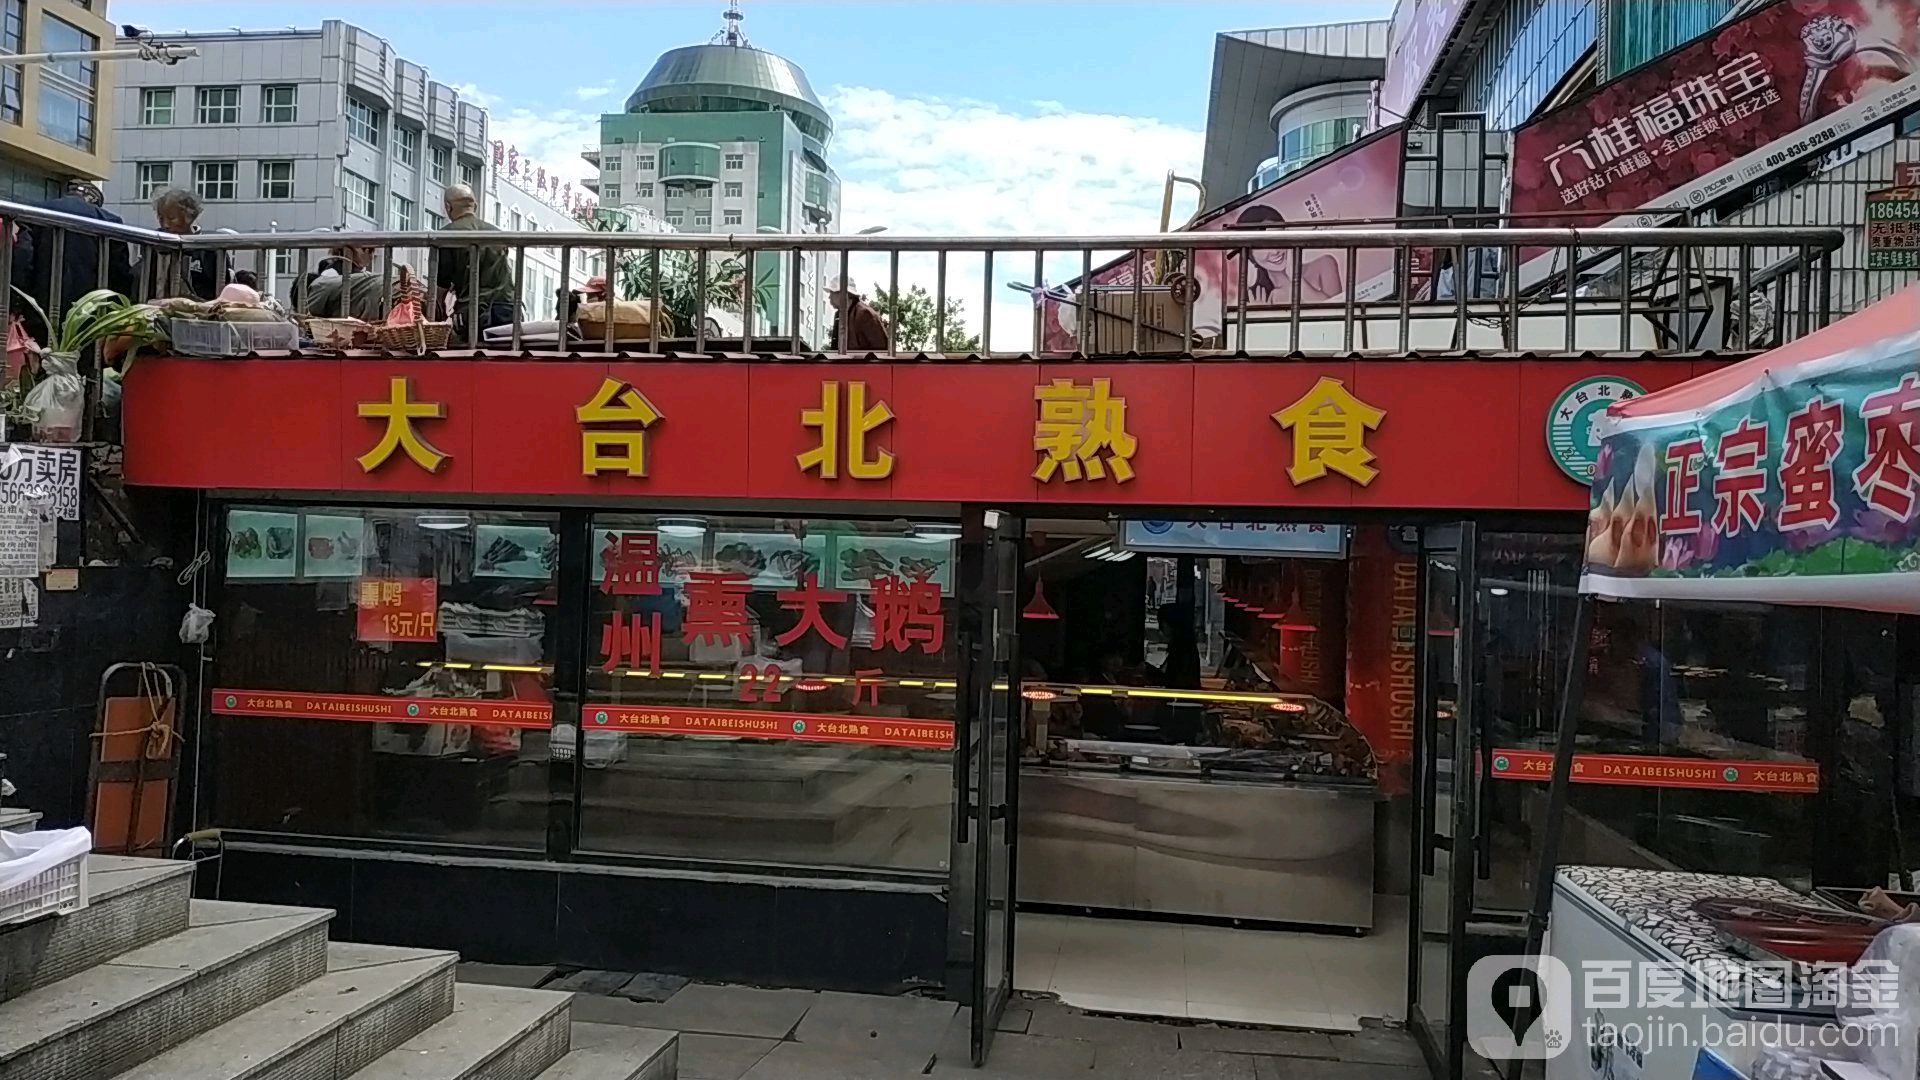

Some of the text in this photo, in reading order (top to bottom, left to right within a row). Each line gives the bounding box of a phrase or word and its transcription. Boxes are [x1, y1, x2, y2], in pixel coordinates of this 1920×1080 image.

[1543, 52, 1771, 187] 六桂福珠宝
[1766, 127, 1836, 167] 400-836-9288
[1869, 202, 1920, 219] 186454
[355, 375, 1388, 486] 大台北熟食
[1658, 370, 1920, 539] 正宗蜜枣
[600, 531, 663, 678] 温州
[681, 571, 945, 654] 熏大鹅
[382, 612, 434, 637] 13元/只
[247, 698, 392, 714] 大台北熟食 DATAIBEISHUSHI
[430, 706, 478, 718] 大台北熟食
[619, 713, 778, 730] 大台北熟食 DATAIBEISHUSHI
[817, 722, 954, 740] 大台北熟食 DATAIBEISH
[1603, 764, 1716, 779] DATAIBEISHUSHI
[1753, 770, 1817, 784] 大台北熟食
